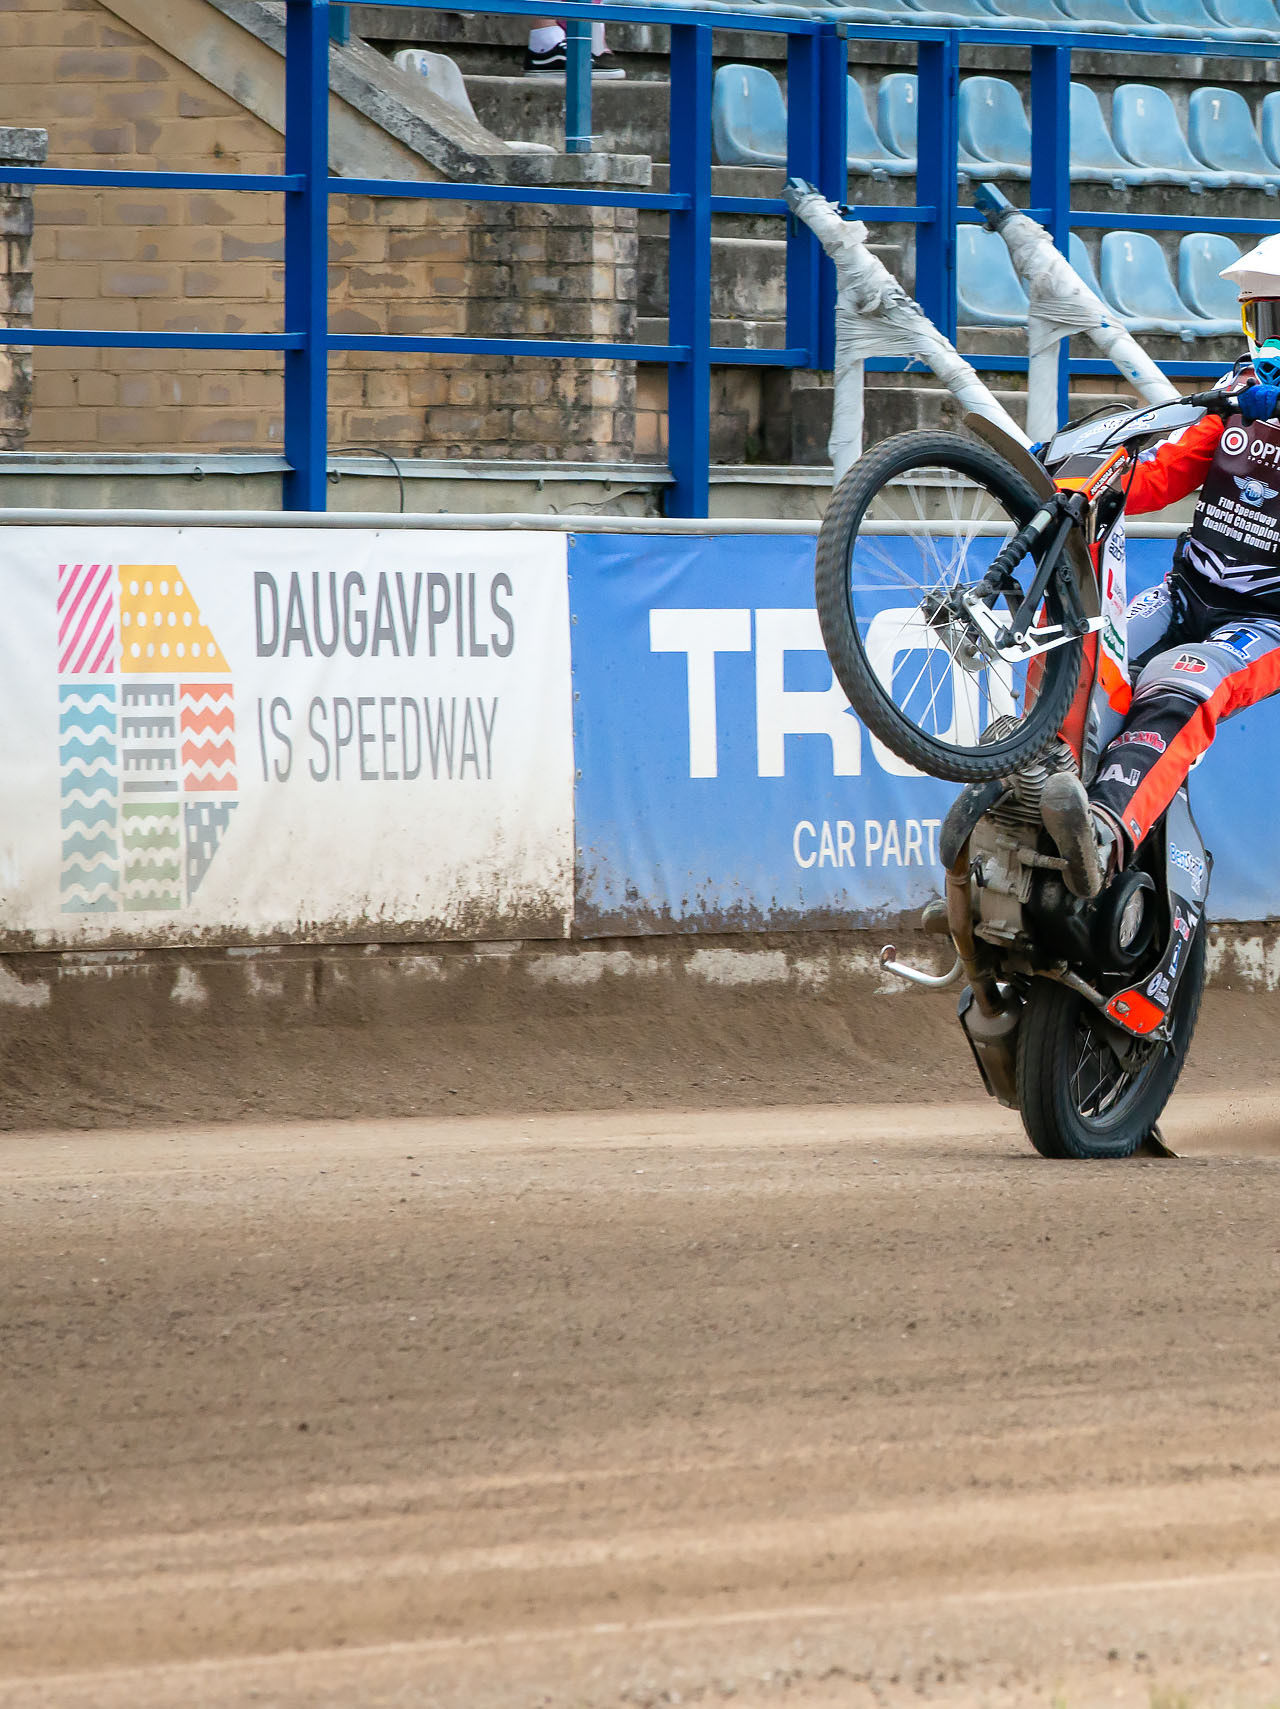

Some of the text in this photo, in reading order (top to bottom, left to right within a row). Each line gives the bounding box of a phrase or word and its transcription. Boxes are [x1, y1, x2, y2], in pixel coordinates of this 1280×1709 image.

[1206, 505, 1233, 523] World
[1219, 496, 1278, 526] FIM Speedway
[1203, 517, 1243, 543] Qualifying
[1243, 532, 1271, 552] Round
[254, 571, 514, 658] DAUGAVPILS
[258, 696, 499, 783] IS SPEEDWAY
[793, 819, 942, 869] CAR PART
